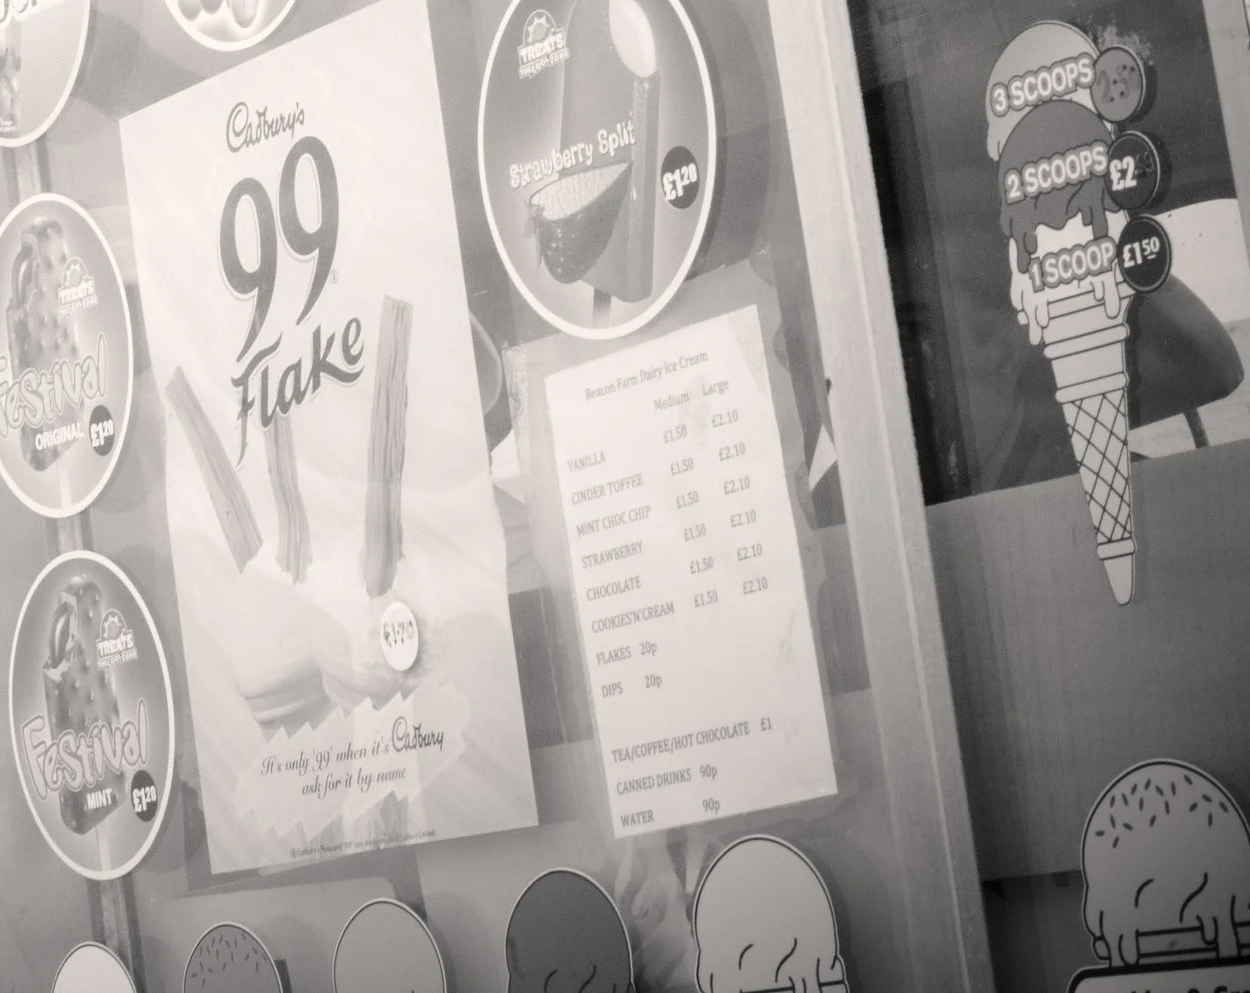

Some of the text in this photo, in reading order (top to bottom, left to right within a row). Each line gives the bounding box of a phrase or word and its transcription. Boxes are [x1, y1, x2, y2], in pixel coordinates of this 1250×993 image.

[993, 57, 1093, 112] 3 SCOOPS
[226, 101, 305, 153] Cadbury's
[509, 120, 636, 188] Strawberry Split
[1007, 173, 1022, 199] 2
[1023, 146, 1108, 194] SCOOPS
[219, 135, 339, 363] 99
[1031, 241, 1114, 288] 1 SCOOP
[584, 351, 709, 401] Beacon Farm Dairy Ice Cream
[654, 379, 729, 412] Medium Large
[36, 422, 85, 450] ORIGINAL
[567, 409, 739, 472] VANILLA £1.50 £2.10
[571, 442, 746, 505] CINDER TOFFEE £1.50 £2.10
[576, 476, 751, 537] MINT CHOC CHIP £1.50 £2.10
[581, 509, 757, 570] STRAWBERRY £1.50 £2.10
[586, 543, 763, 602] CHOCOLATE £1.50 £2.10
[693, 589, 719, 608] £1.50
[742, 576, 769, 595] £2.10
[596, 640, 658, 667] FLAKES 20p
[601, 673, 663, 698] DIPS 20p
[22, 698, 148, 800] Festival
[260, 715, 445, 776] It's only '99' when it's Cadbury
[610, 716, 773, 764] TEA/COFFEE/HOT CHOCOLATE £1
[86, 788, 113, 810] MINT
[301, 767, 406, 800] ask for it by name
[616, 763, 718, 796] CANNED DRINKS 90p
[621, 796, 721, 828] WATER 90p
